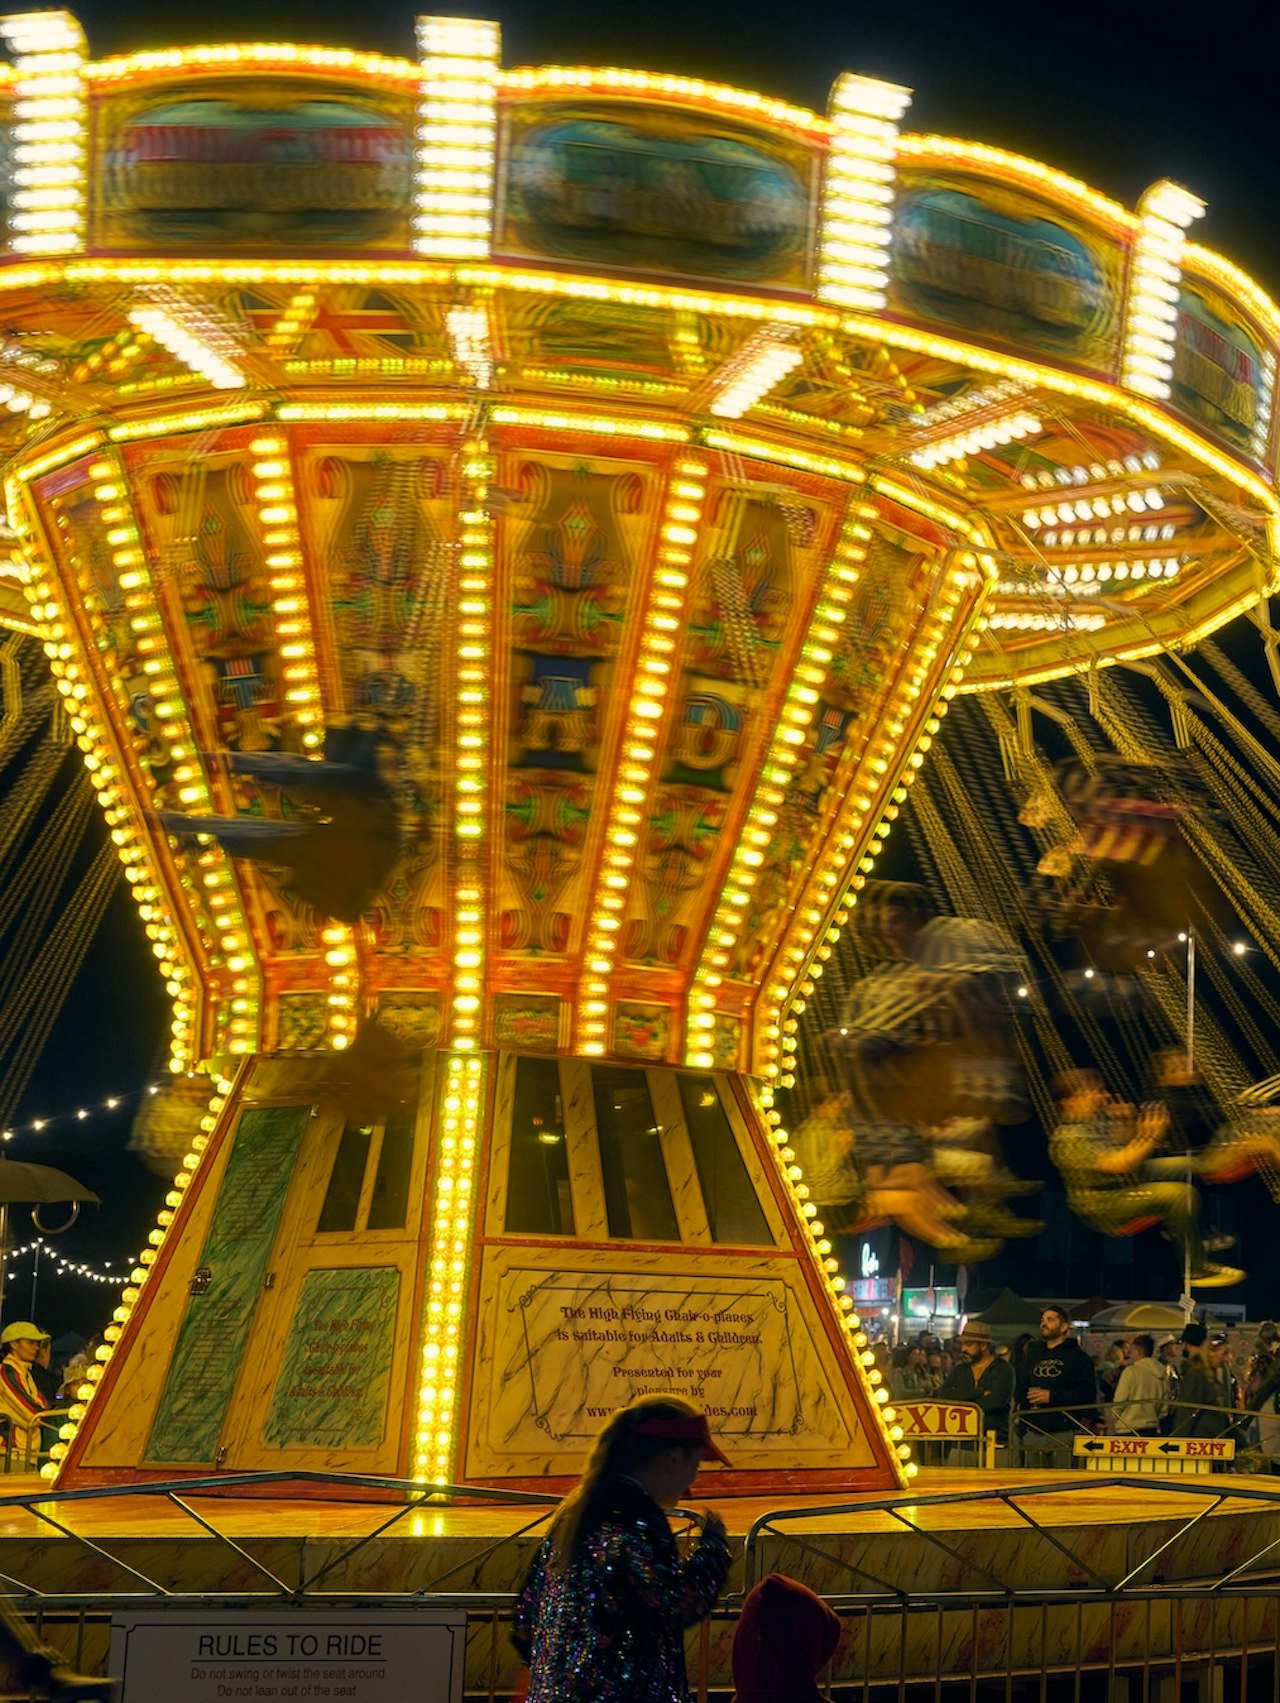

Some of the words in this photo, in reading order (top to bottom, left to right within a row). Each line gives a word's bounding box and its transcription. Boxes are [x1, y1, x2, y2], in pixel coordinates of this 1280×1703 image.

[559, 1306, 586, 1320] The
[589, 1306, 619, 1322] High
[621, 1306, 662, 1323] Flying
[664, 1308, 755, 1324] Chair-o-planes
[556, 1328, 570, 1342] is
[572, 1329, 627, 1343] suitable
[628, 1331, 649, 1343] for
[650, 1331, 693, 1344] Adults
[696, 1331, 706, 1344] &
[612, 1366, 675, 1379] Presented
[677, 1366, 695, 1379] for
[697, 1369, 723, 1382] your
[690, 1385, 705, 1399] by
[1109, 1439, 1150, 1454] EXIT
[1185, 1441, 1227, 1456] EXIT
[198, 1634, 279, 1656] RULES
[286, 1634, 319, 1656] TO
[326, 1634, 383, 1656] RIDE
[190, 1667, 207, 1680] Do
[209, 1668, 227, 1680] not
[228, 1667, 261, 1683] swing
[262, 1670, 275, 1680] or
[276, 1668, 301, 1680] twist
[302, 1667, 321, 1680] the
[323, 1668, 347, 1680] seat
[348, 1667, 386, 1680] around
[217, 1685, 234, 1697] Do
[235, 1686, 254, 1697] not
[255, 1685, 279, 1697] lean
[281, 1686, 299, 1697] out
[301, 1684, 313, 1697] of
[313, 1684, 331, 1696] the
[332, 1685, 357, 1696] seat
